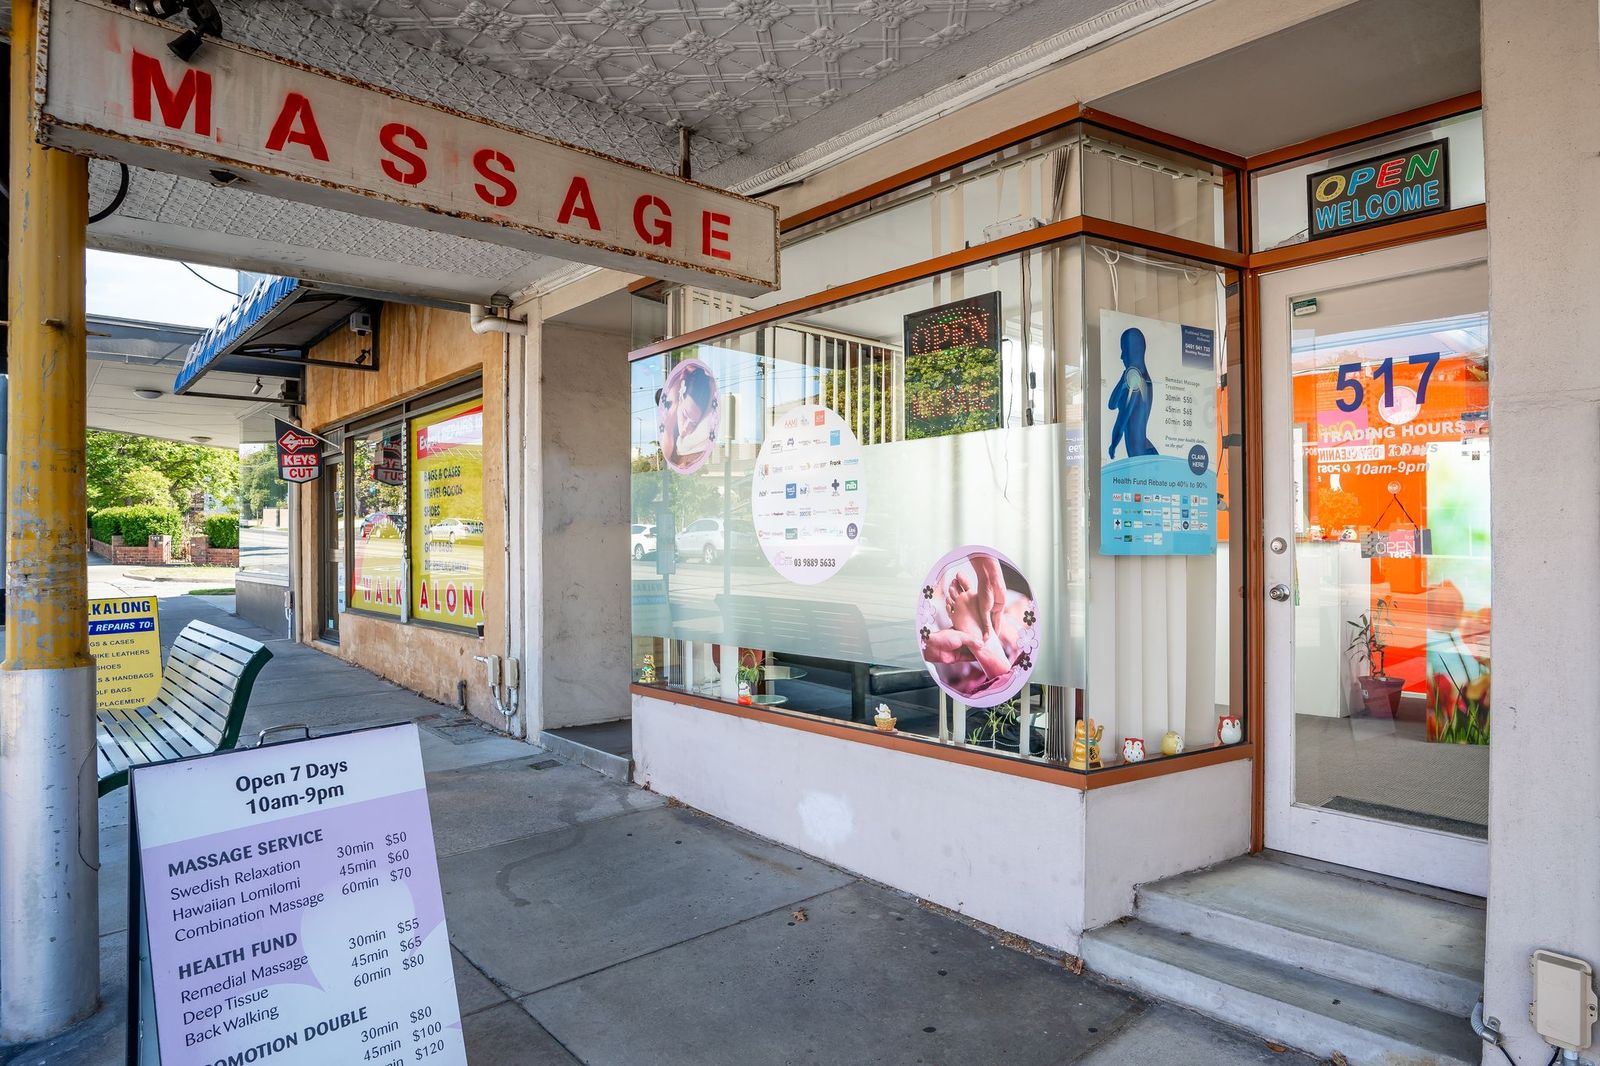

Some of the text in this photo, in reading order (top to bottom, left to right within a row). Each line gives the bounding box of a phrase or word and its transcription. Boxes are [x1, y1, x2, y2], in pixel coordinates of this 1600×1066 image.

[131, 48, 733, 261] MASSAGE
[1315, 149, 1439, 202] OPEN
[1316, 179, 1439, 231] WELCOME
[912, 311, 990, 354] OPEN
[1335, 352, 1440, 413] 517
[1320, 427, 1396, 442] TRADING
[1402, 421, 1466, 437] HOURS
[284, 455, 316, 466] KEYS
[289, 468, 314, 478] CUT
[424, 469, 438, 482] BAGS
[443, 466, 461, 479] CASES
[1354, 461, 1431, 475] 10am-9pm
[1113, 477, 1131, 485] Health
[1148, 479, 1167, 487] Rebate
[424, 505, 440, 517] SHOES
[793, 558, 801, 567] 03
[803, 558, 818, 567] 9889
[820, 558, 836, 567] 5633
[1376, 541, 1416, 554] OPEN
[88, 600, 151, 615] KALONG
[96, 622, 135, 632] REPAIRS
[139, 621, 153, 629] TO:
[112, 649, 150, 658] LEATHERS
[111, 687, 132, 695] BAGS
[112, 673, 154, 682] HANDBAGS
[236, 758, 348, 794] Open 7 Days
[246, 783, 344, 815] 10am-9pm
[168, 829, 323, 877] MASSAGE SERVICE
[337, 831, 407, 858] 30min $50
[339, 849, 409, 877] 45min $60
[171, 858, 301, 901] Swedish Relaxation
[342, 866, 412, 896] 60min $70
[173, 877, 301, 921] Hawaiian Lomilomi
[175, 891, 324, 942] Combination Massage
[348, 918, 419, 950] 30min $55
[178, 932, 297, 979] HEALTH FUND
[351, 936, 422, 968] 45min $65
[181, 953, 308, 1004] Remedial Massage
[354, 954, 425, 988] 60min $80
[184, 988, 269, 1026] Deep Tissue
[186, 1004, 280, 1047] Back Walking
[304, 1007, 368, 1042] DOUBLE
[361, 1006, 432, 1043] 30min $80
[363, 1021, 442, 1062] 45min $100
[415, 1039, 445, 1061] $120
